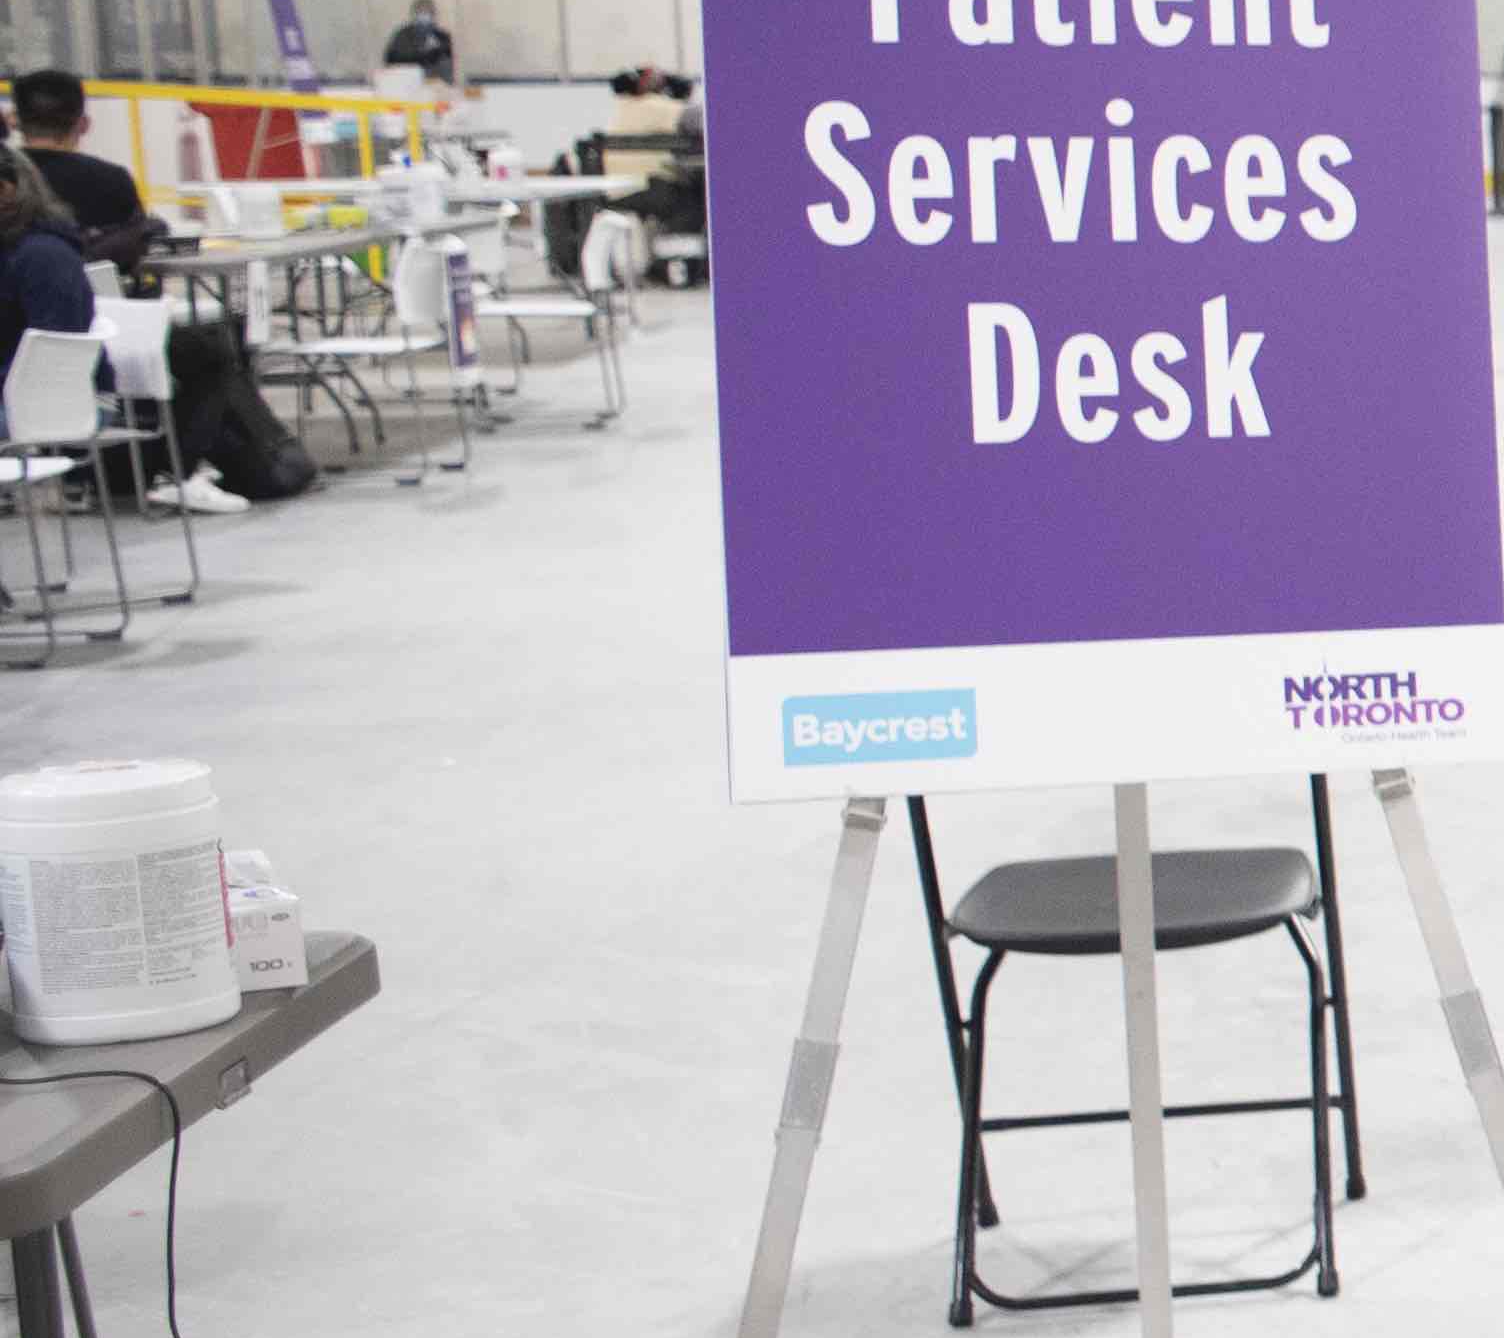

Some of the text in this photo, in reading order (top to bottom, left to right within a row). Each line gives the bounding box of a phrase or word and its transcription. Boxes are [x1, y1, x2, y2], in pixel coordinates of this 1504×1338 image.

[806, 100, 1357, 247] Services
[969, 296, 1271, 444] Desk
[1284, 671, 1417, 703] NORTH
[794, 707, 966, 753] Baycrest
[1286, 698, 1466, 730] TORONTO
